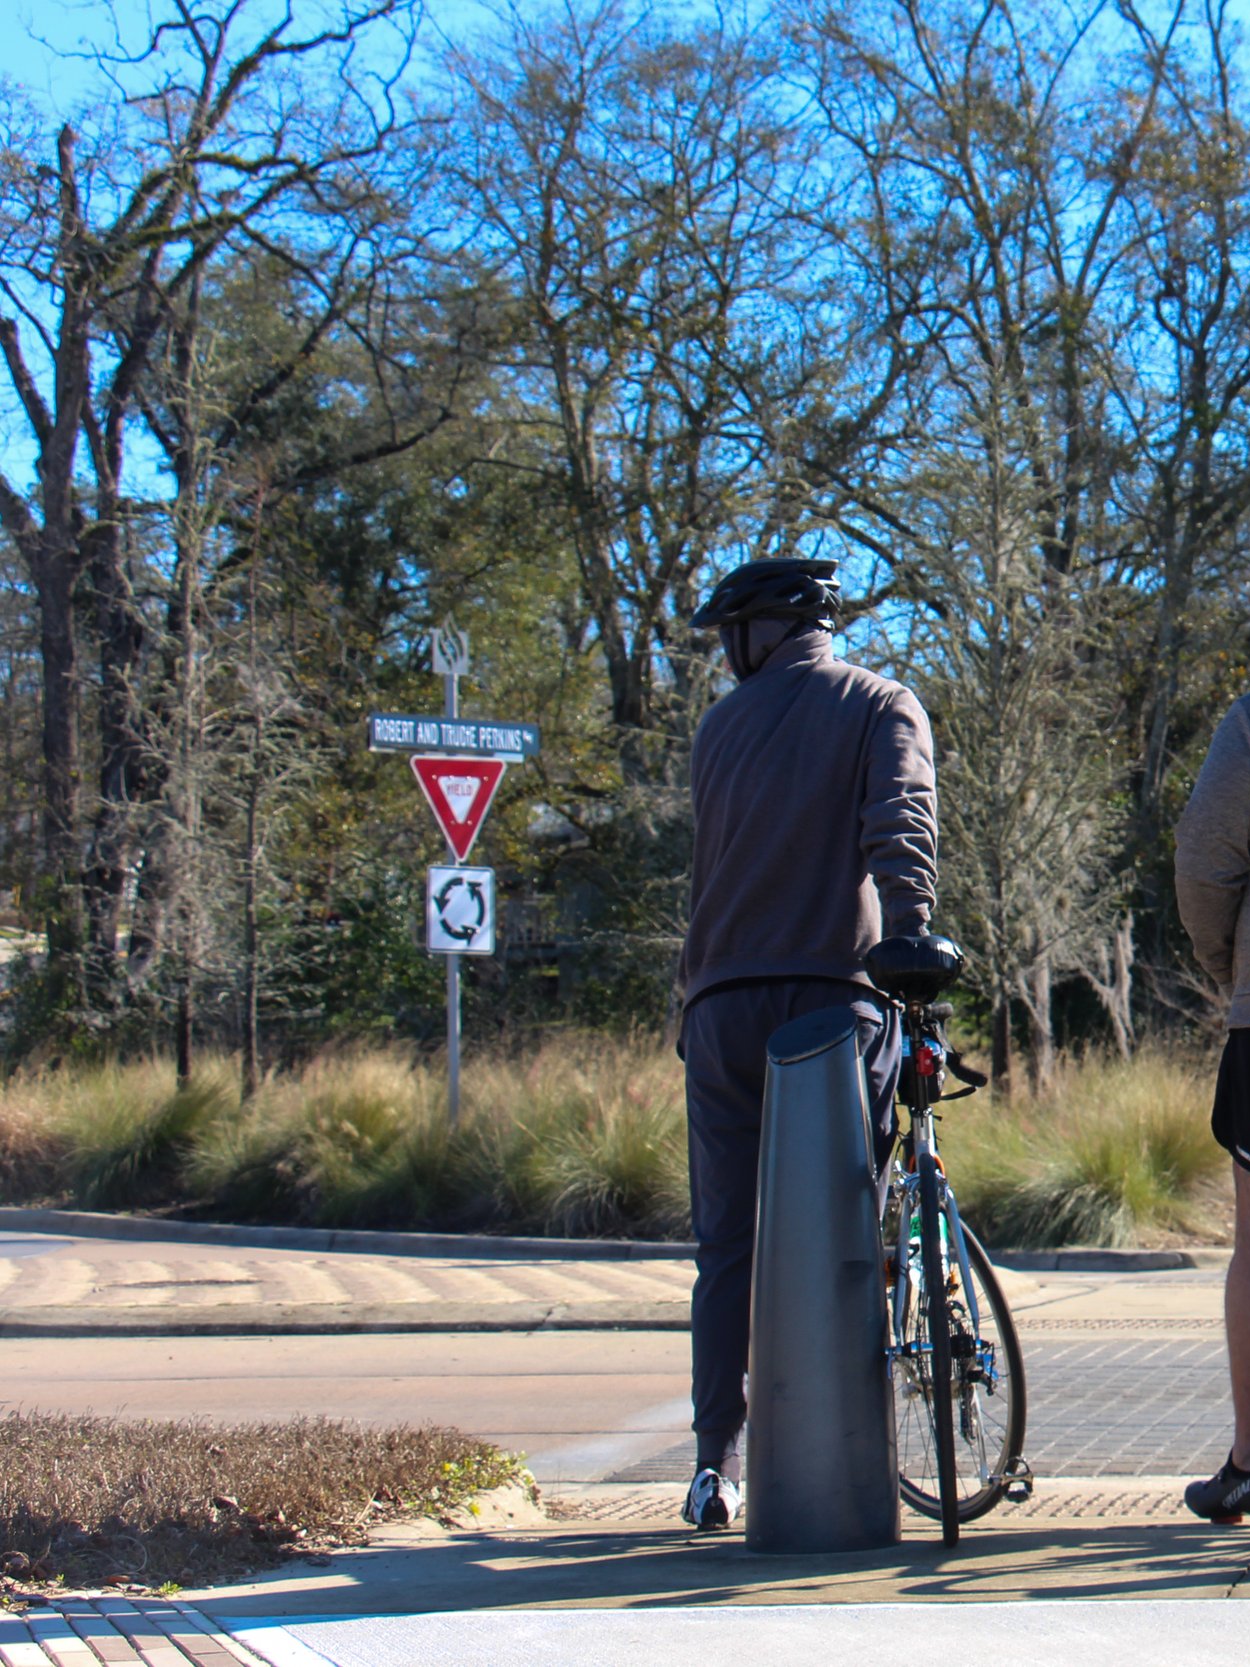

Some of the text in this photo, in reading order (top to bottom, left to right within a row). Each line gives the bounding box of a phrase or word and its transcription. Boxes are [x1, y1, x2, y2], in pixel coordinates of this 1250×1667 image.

[374, 718, 414, 743] ROBERT
[417, 722, 439, 745] AND
[479, 727, 522, 751] PERKINS
[447, 783, 474, 797] YIELD
